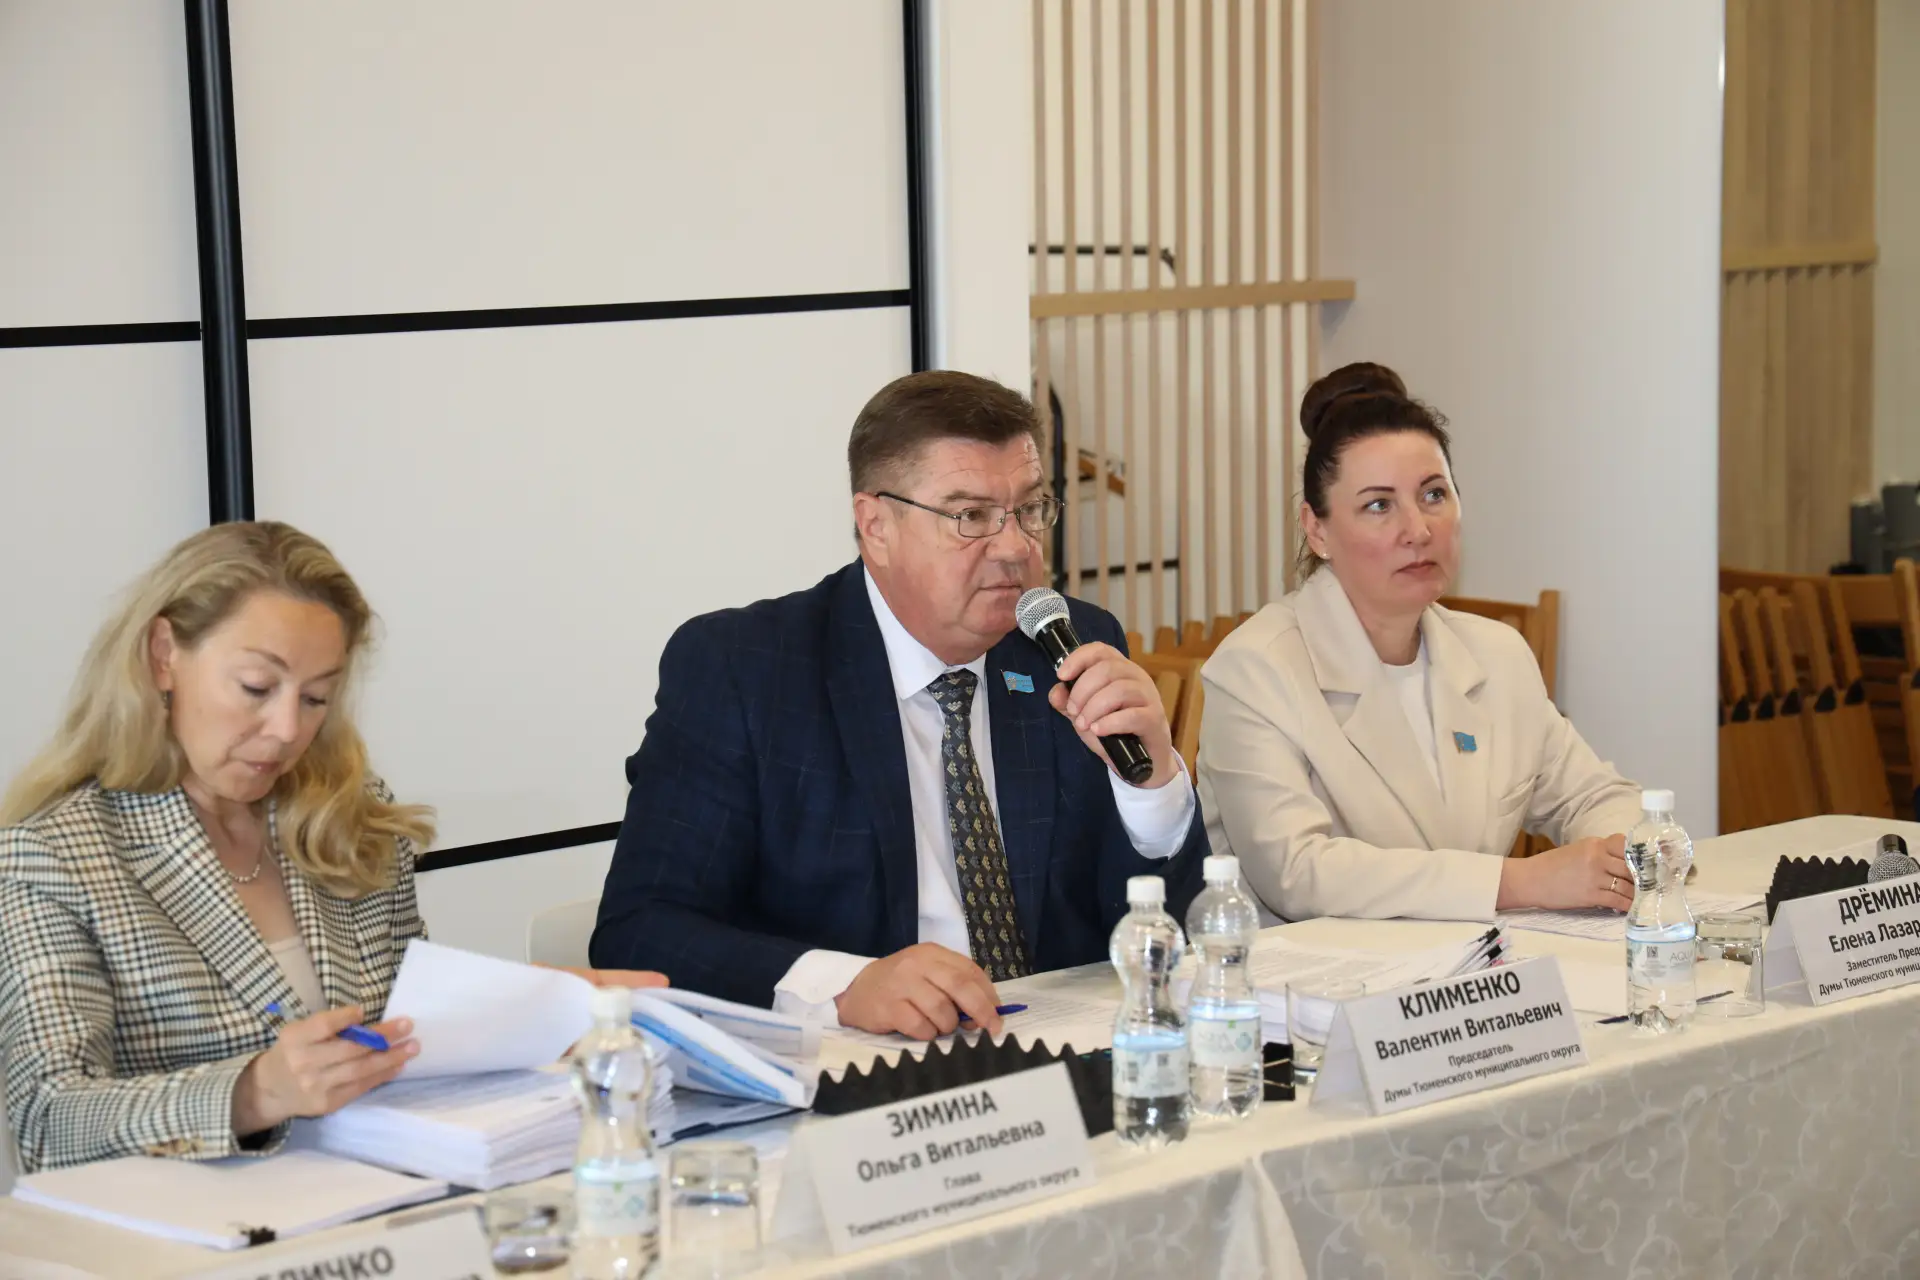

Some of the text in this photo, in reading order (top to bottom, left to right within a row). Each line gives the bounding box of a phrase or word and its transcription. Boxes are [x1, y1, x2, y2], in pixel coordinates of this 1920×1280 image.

[1838, 882, 1920, 925] ДРЁМИНА
[1829, 919, 1920, 953] Елена Лазар
[1846, 946, 1920, 972] Заместитель Пред
[1398, 971, 1521, 1020] КЛИМЕНКО
[1819, 982, 1843, 996] Думы
[1843, 968, 1894, 988] Тюменского
[1375, 1002, 1563, 1060] Валентин Витальевич
[1384, 1043, 1581, 1103] Думы Тюменского муниципального округа
[1448, 1042, 1514, 1068] Председатель
[886, 1090, 998, 1138] ЗИМИНА
[857, 1118, 1046, 1183] Ольга Витальевна
[847, 1207, 930, 1237] Тюменского
[1039, 1166, 1080, 1187] округа
[943, 1171, 983, 1190] Глава
